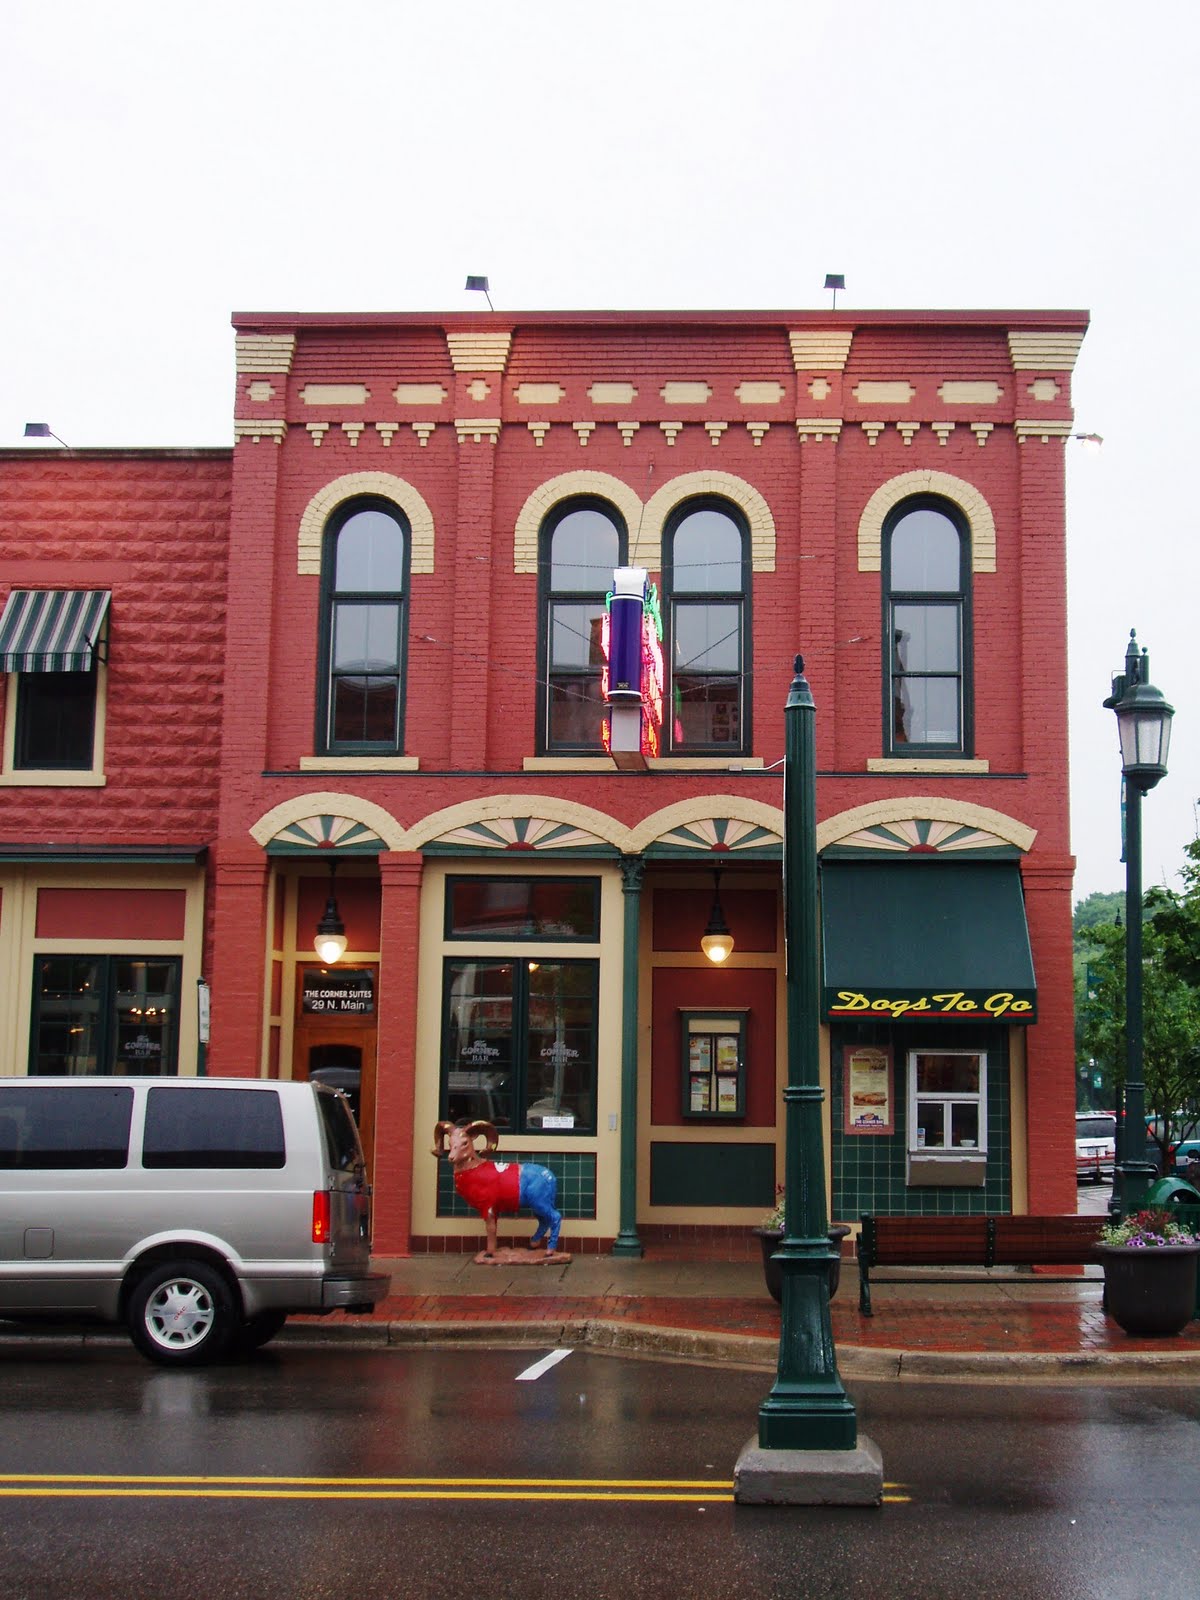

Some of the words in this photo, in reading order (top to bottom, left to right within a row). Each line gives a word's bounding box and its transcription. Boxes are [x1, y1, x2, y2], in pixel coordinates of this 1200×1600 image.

[304, 990, 319, 998] THE
[320, 990, 348, 998] CORNER
[348, 990, 372, 998] SUITES
[311, 1000, 325, 1010] 29
[327, 1000, 338, 1010] N.
[341, 1000, 365, 1010] Main
[831, 991, 931, 1018] Dogs
[932, 992, 978, 1012] To
[983, 992, 1032, 1018] Go
